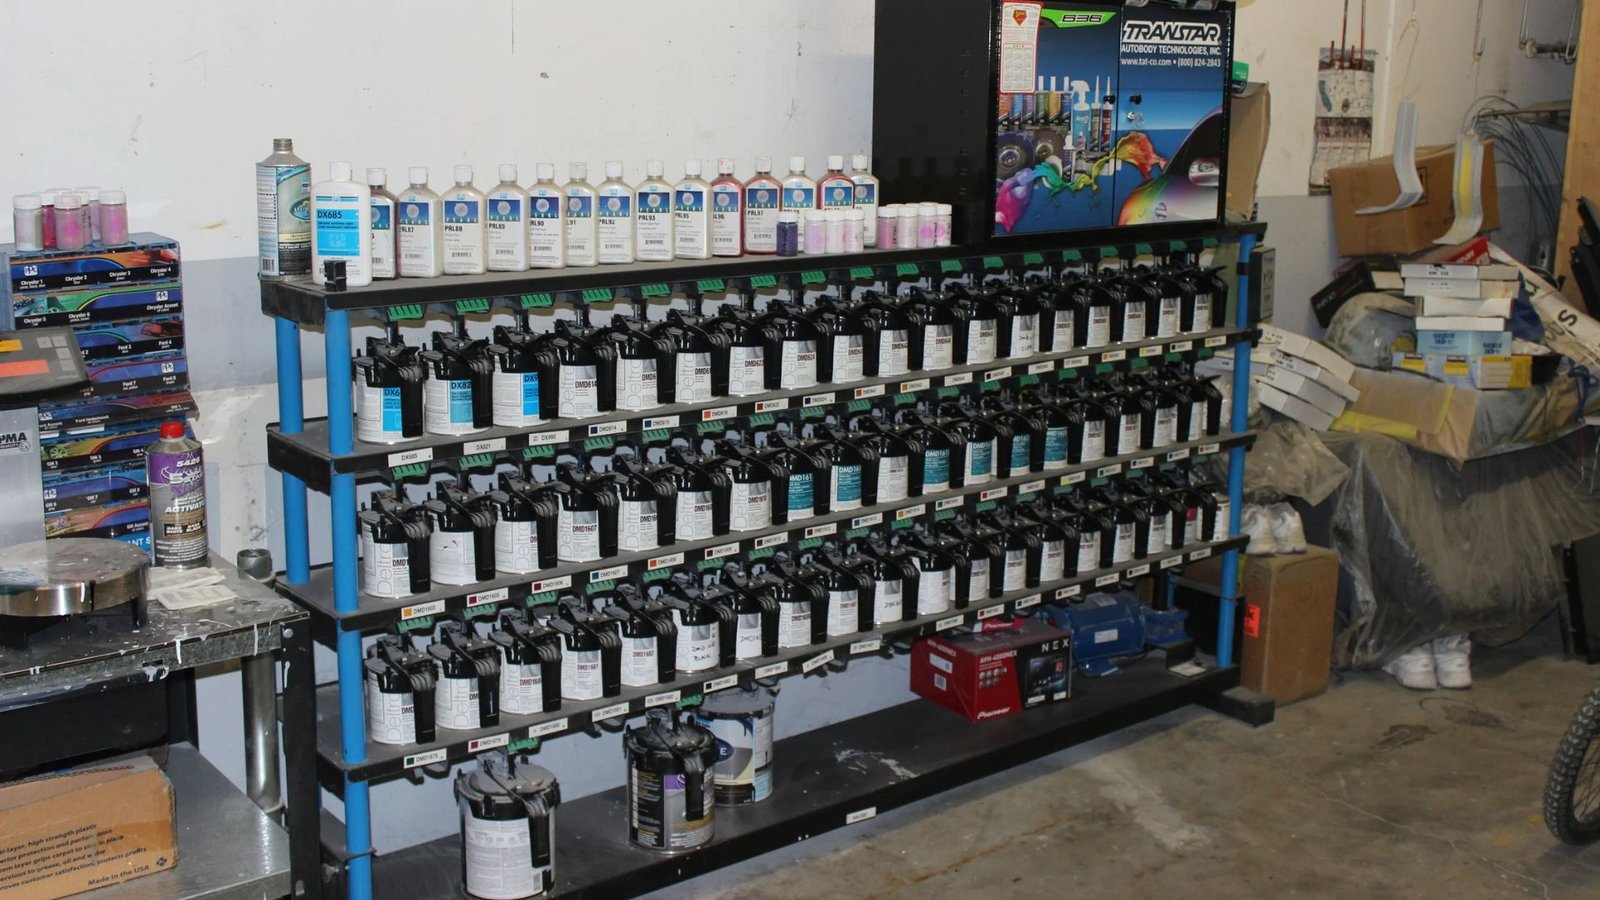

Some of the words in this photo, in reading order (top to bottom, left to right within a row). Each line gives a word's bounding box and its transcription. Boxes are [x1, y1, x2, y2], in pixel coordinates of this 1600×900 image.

[1123, 21, 1220, 44] TRANSTAR
[1121, 44, 1157, 54] AUTOBODY
[1159, 45, 1208, 56] TECHNOLOGIES,
[1209, 47, 1221, 55] INC.
[1120, 58, 1172, 66] www.tat-co.com
[1177, 58, 1193, 68] (800)
[1194, 58, 1221, 67] 824-2843
[317, 210, 342, 219] DX685
[573, 524, 597, 532] DMD1607
[1042, 638, 1069, 653] NEX
[977, 707, 1010, 719] Pioneer
[719, 747, 728, 756] E
[28, 838, 44, 848] high
[45, 829, 75, 843] strength
[18, 844, 55, 860] protection
[55, 840, 70, 849] and
[14, 860, 32, 870] layer
[33, 855, 51, 865] grips
[52, 848, 74, 858] carpet
[21, 871, 54, 886] customer
[87, 875, 110, 886] Made
[120, 869, 133, 878] the
[134, 864, 150, 874] USA
